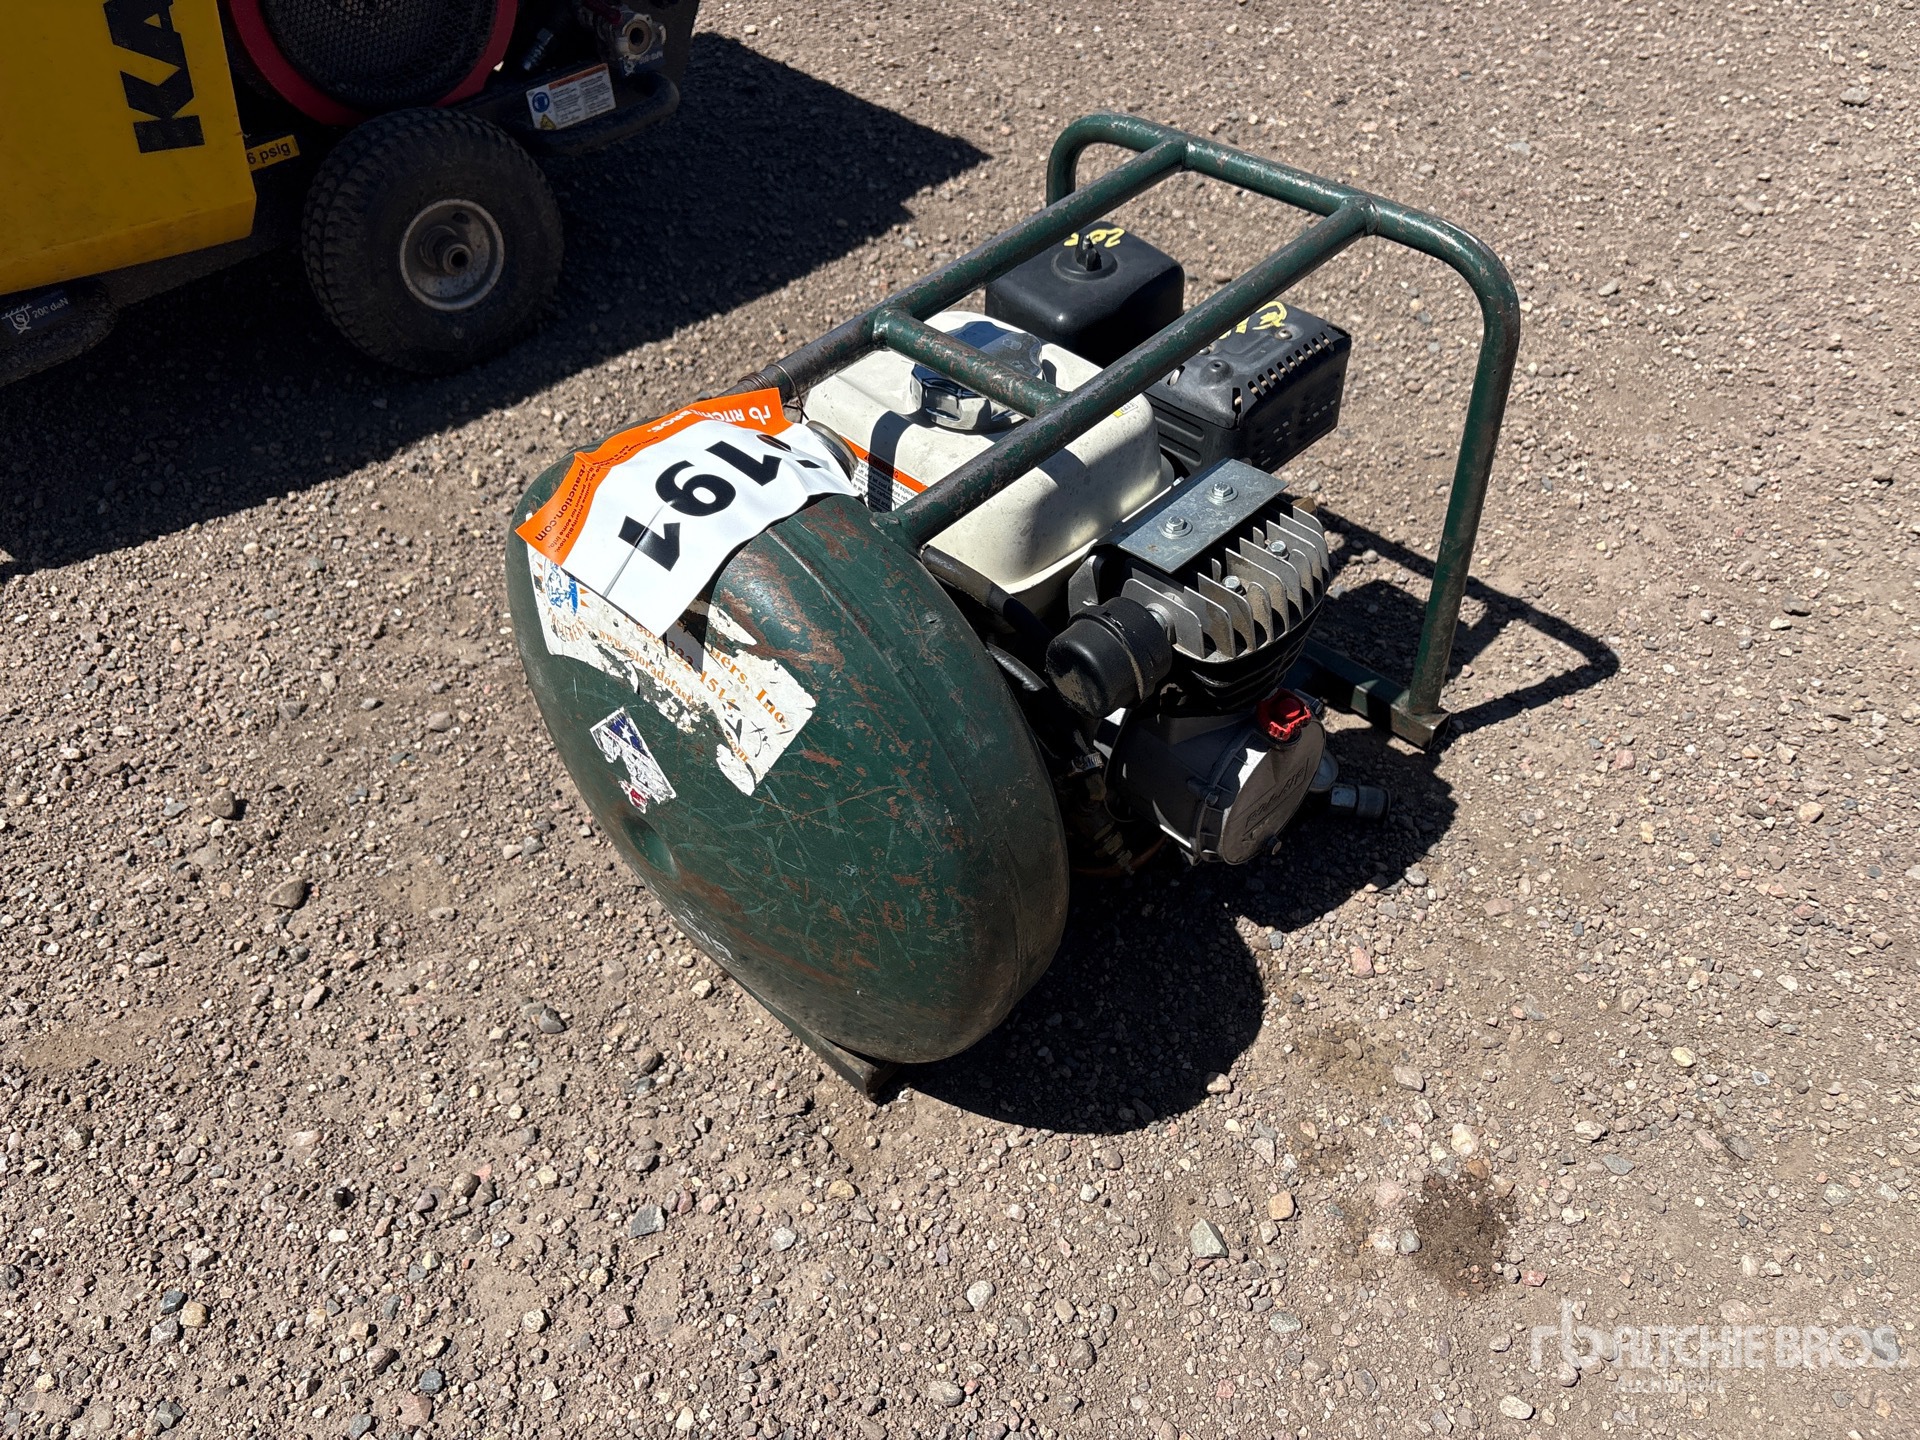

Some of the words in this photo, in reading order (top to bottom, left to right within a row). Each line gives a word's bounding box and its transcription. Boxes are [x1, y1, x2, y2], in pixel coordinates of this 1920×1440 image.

[259, 142, 292, 164] psig
[646, 409, 692, 433] BROS.
[749, 404, 772, 426] rb
[534, 463, 586, 542] rbauction.com
[617, 440, 821, 572] 191
[559, 518, 572, 536] some
[554, 538, 567, 553] now.
[755, 688, 788, 730] Inc.
